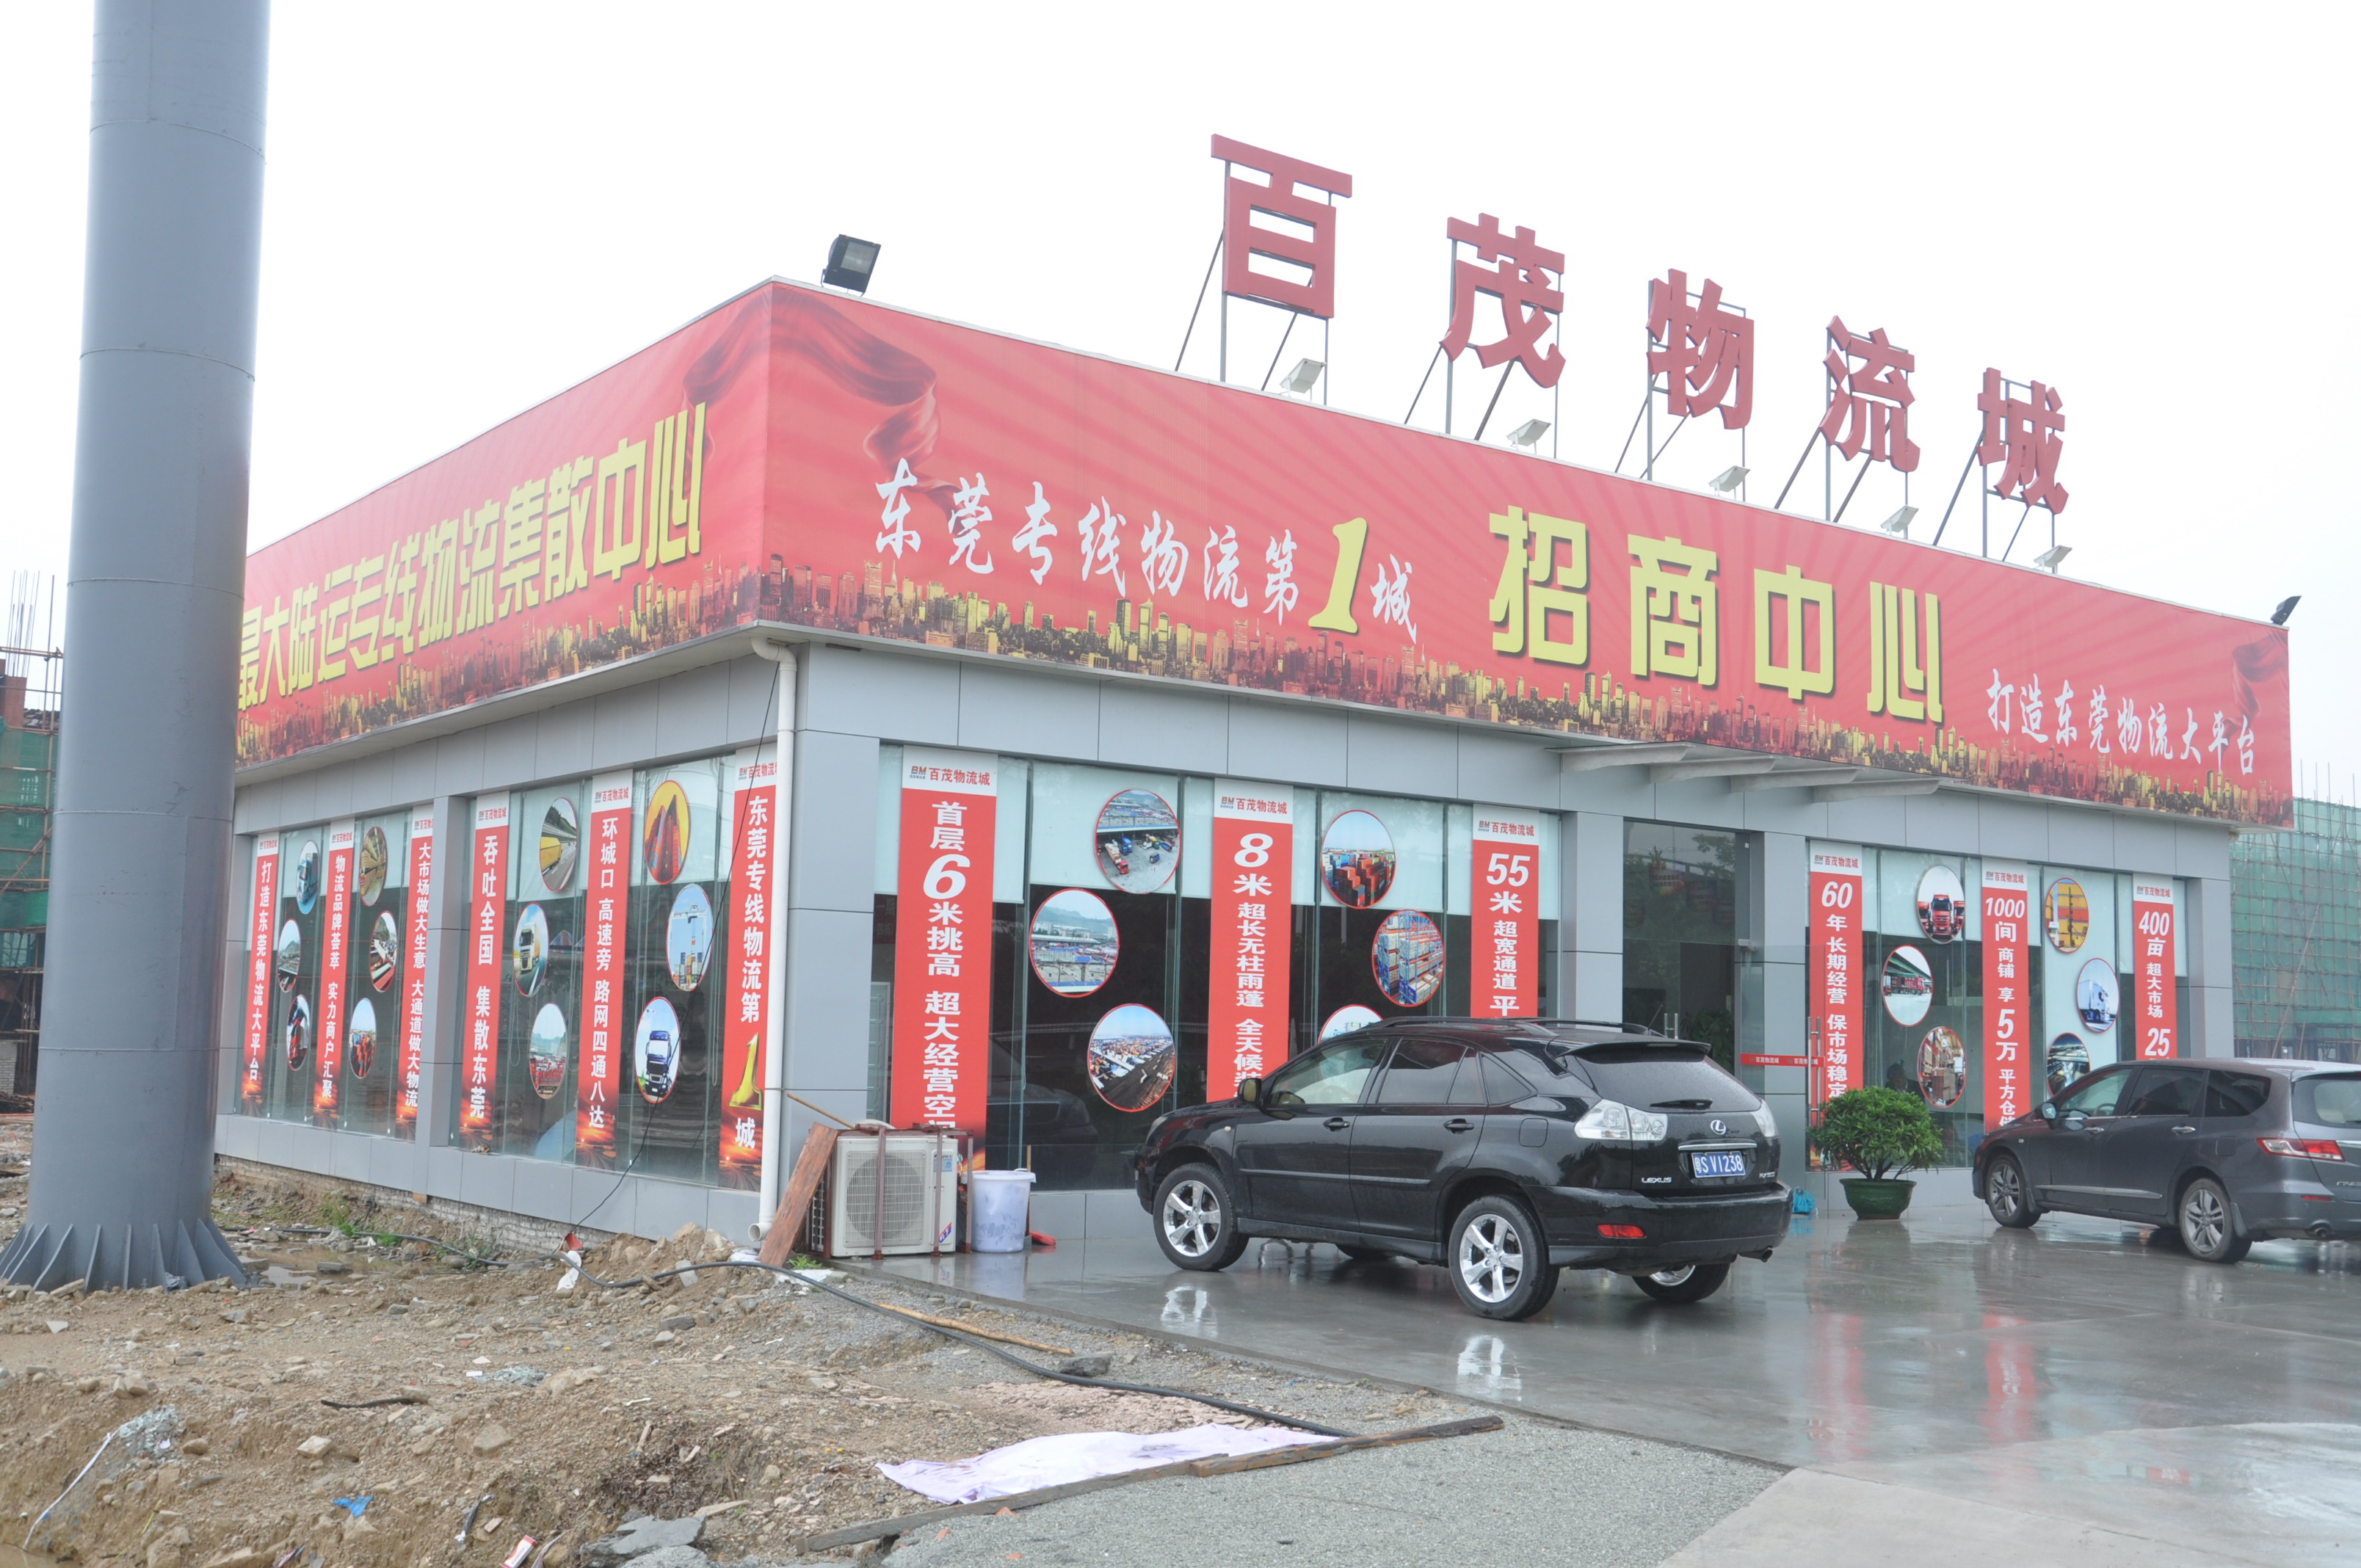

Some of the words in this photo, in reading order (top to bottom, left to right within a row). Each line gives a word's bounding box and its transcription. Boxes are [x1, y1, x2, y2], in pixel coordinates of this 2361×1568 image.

[1211, 132, 2069, 514] 百茂物流城
[238, 402, 706, 711] 最大陆运专线物流集散中心
[875, 457, 1417, 643] 东莞专线物流第1城
[1489, 504, 1943, 723] 招商中心
[910, 766, 927, 775] BM
[929, 767, 991, 786] 百茂物流城
[1986, 668, 2255, 776] 打造东莞物流大平台
[600, 817, 619, 889] 环城口
[1236, 797, 1288, 815] 百茂物流城
[1491, 821, 1535, 837] 百茂物流城
[1824, 855, 1859, 868] 百茂物流城
[329, 854, 346, 970] 物流品牌荟萃
[413, 842, 432, 969] 大市场做大生意
[479, 835, 498, 965] 吞吐全国
[596, 898, 614, 972] 高速旁
[923, 801, 971, 977] 首层6米挑高
[250, 860, 272, 1081] 打造东莞物流大平台
[728, 795, 769, 1150] 东莞专线物流第1城
[322, 981, 338, 1098] 实力商户汇聚
[405, 979, 424, 1108] 大通道做大物流
[470, 985, 491, 1119] 集散东莞
[589, 979, 611, 1128] 路网四通八达
[2144, 1027, 2171, 1056] 25
